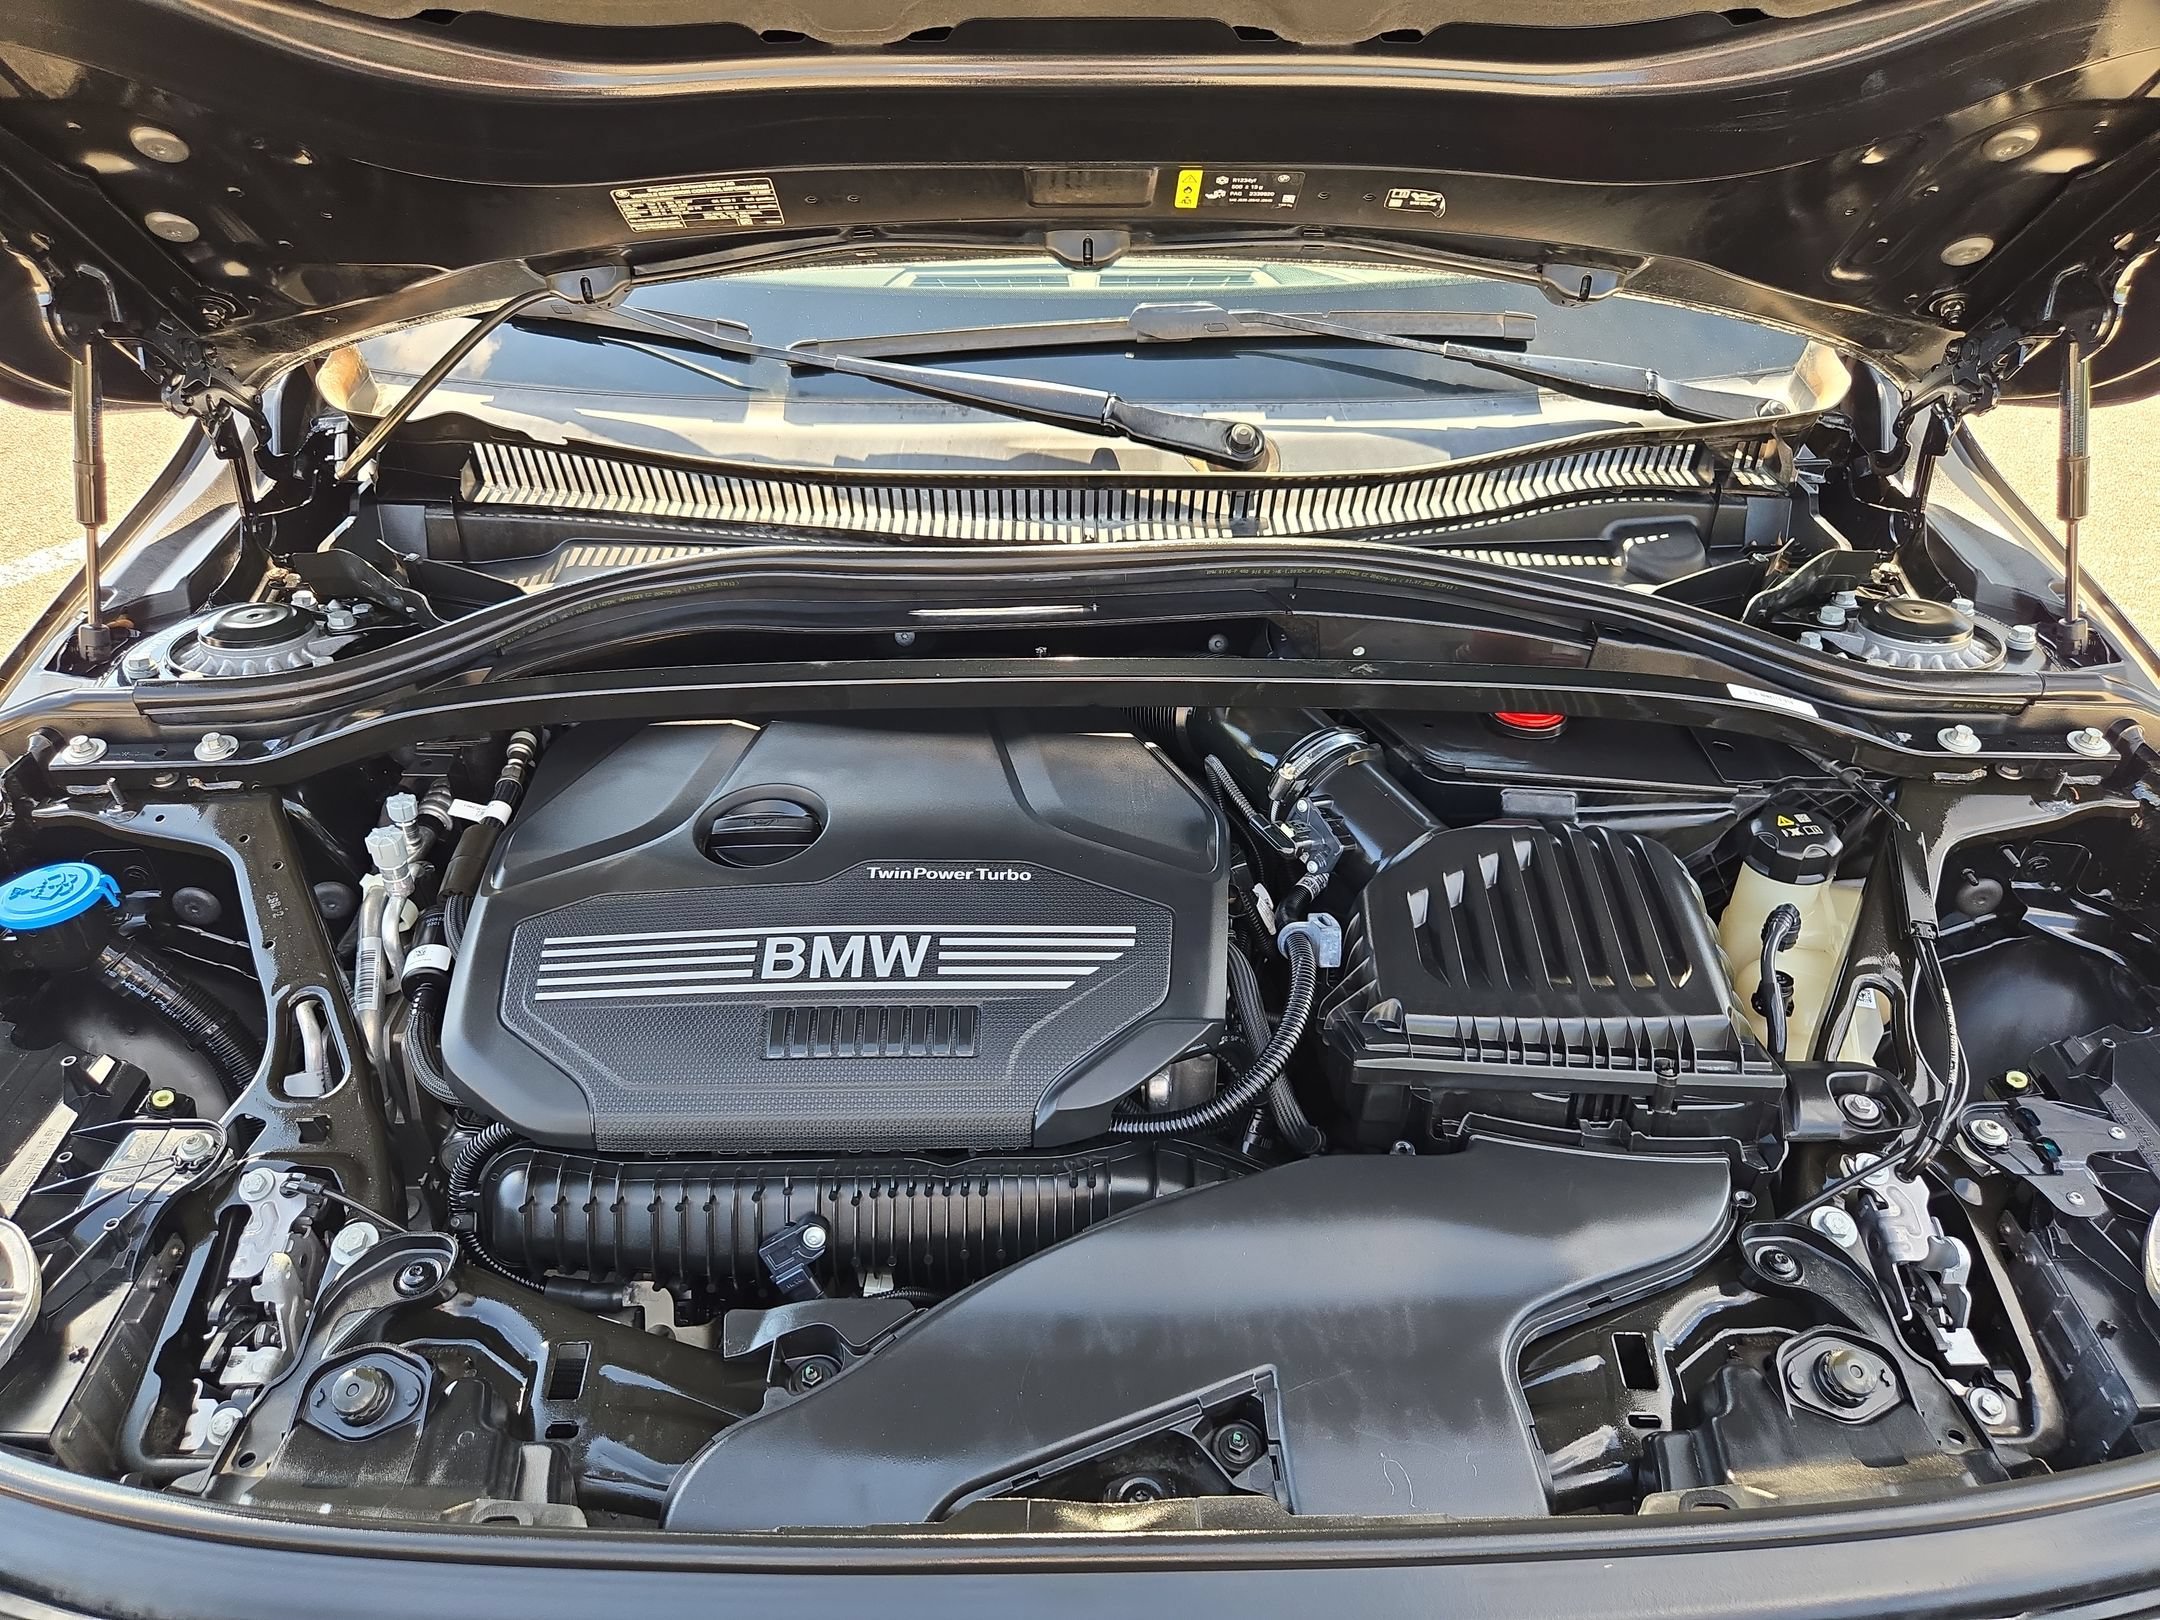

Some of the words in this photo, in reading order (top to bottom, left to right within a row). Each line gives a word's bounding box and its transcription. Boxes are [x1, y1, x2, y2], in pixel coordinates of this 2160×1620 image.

[867, 867, 973, 880] TwinPower
[975, 868, 1032, 881] Turbo
[761, 935, 932, 979] BMW
